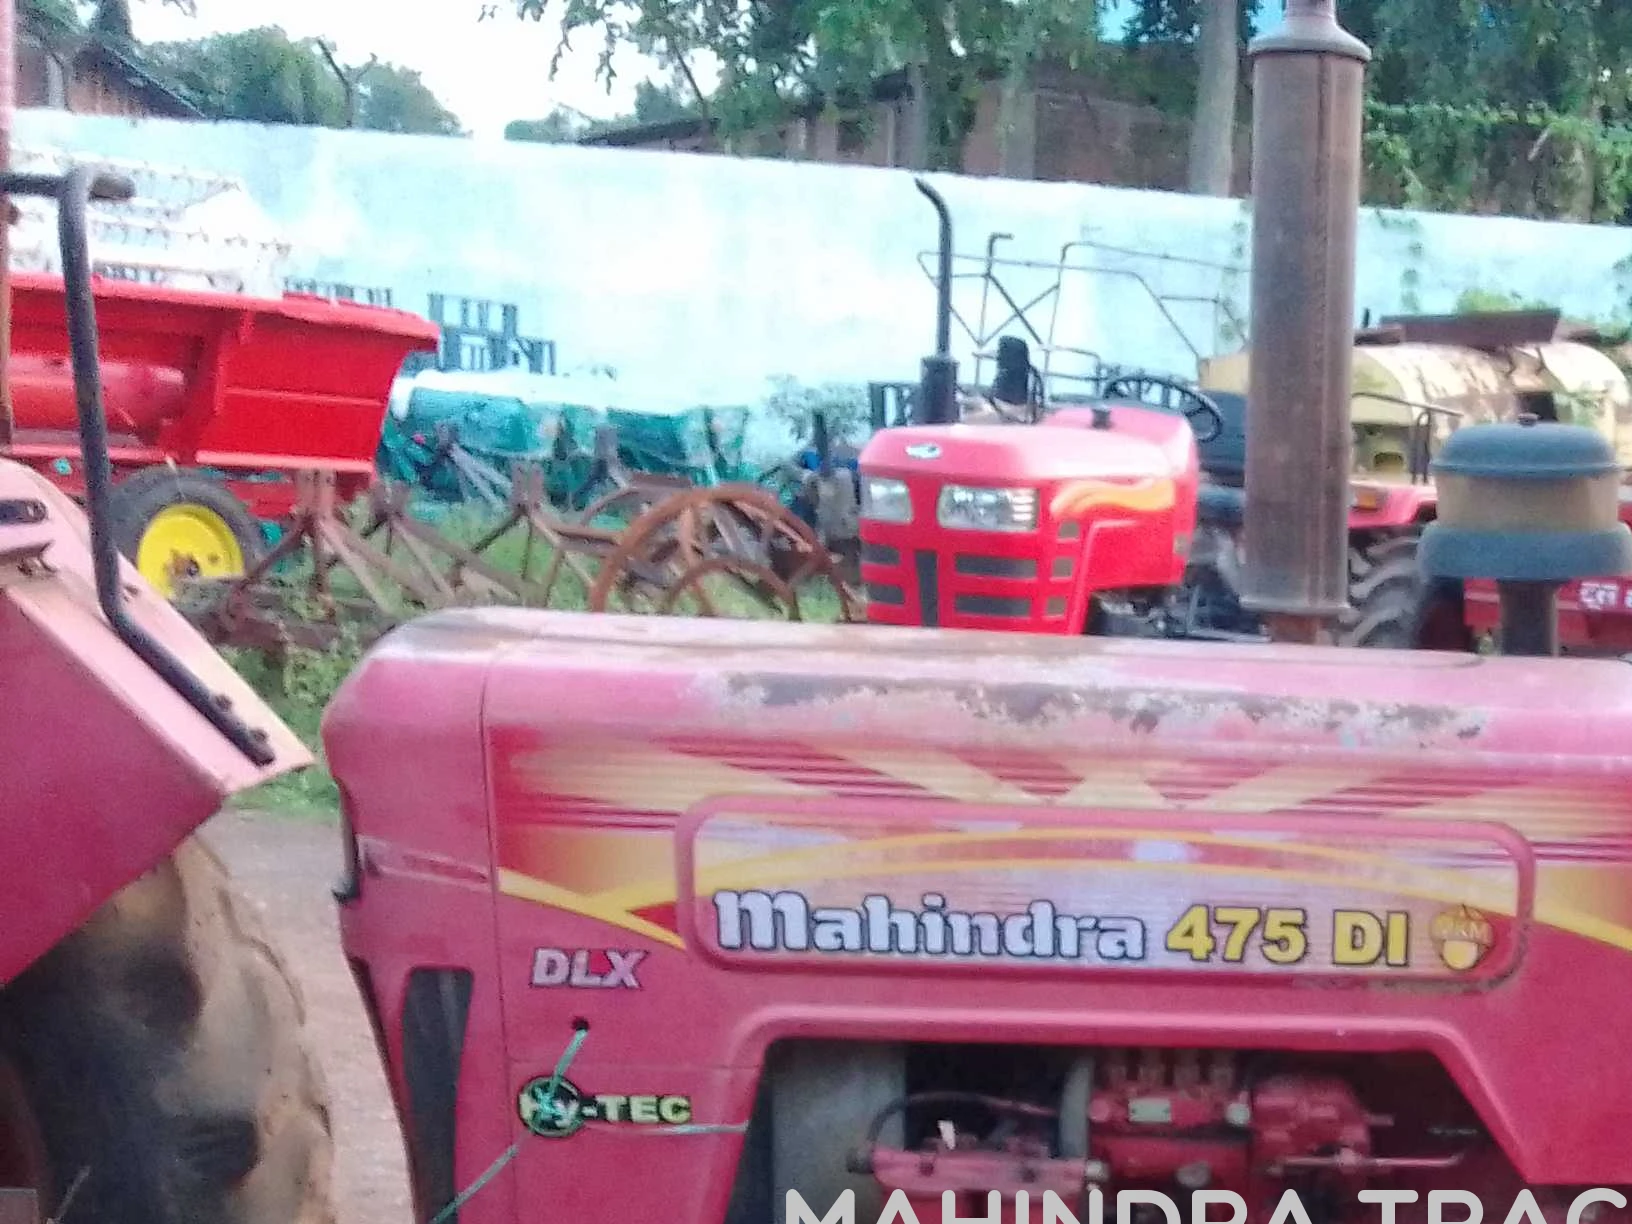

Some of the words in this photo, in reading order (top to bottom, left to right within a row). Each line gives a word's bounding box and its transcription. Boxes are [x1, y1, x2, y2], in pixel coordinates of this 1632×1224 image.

[713, 891, 1147, 962] Mahindra
[1165, 903, 1309, 964] 475
[1332, 908, 1410, 967] DI
[530, 946, 648, 989] DLX
